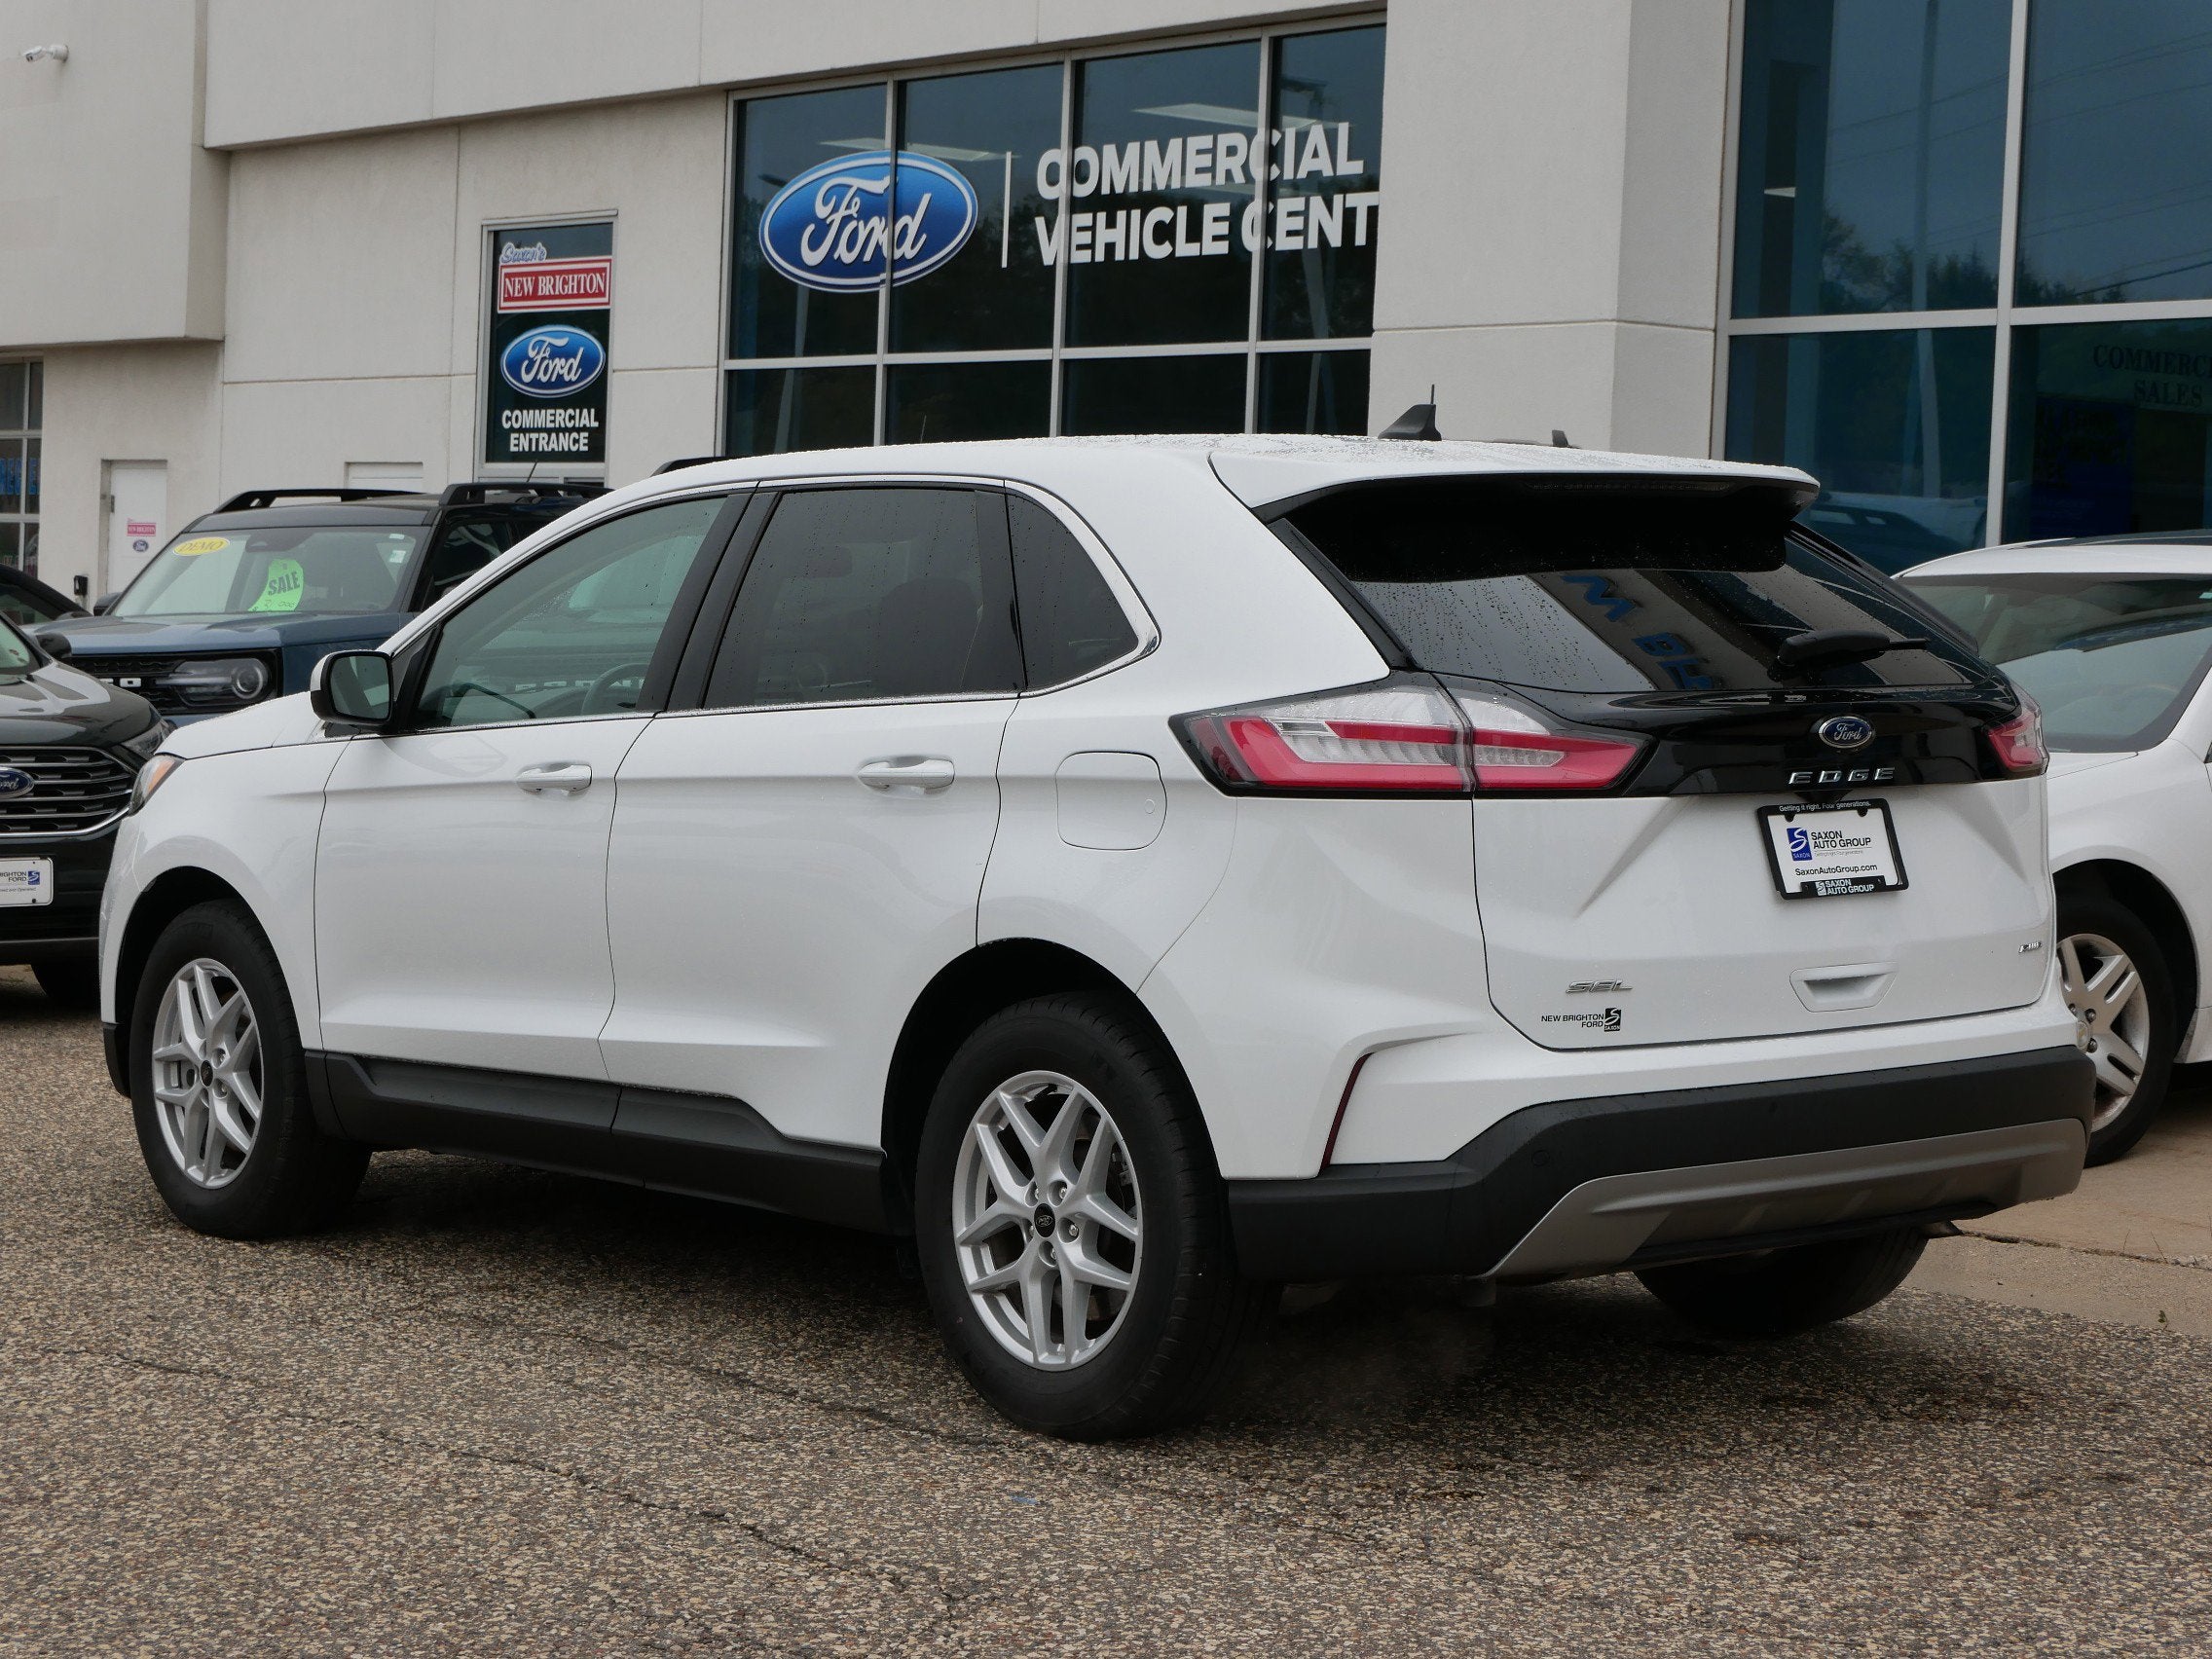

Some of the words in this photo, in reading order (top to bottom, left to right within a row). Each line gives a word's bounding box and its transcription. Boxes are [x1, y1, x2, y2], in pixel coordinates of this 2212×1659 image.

[1037, 122, 1364, 200] COMMERCIAL
[800, 175, 932, 267] Ford
[1034, 202, 1231, 267] VEHICLE
[1241, 191, 1380, 252] CENT
[504, 276, 535, 298] NEW
[537, 273, 606, 296] BRIGHTON
[520, 335, 584, 384] Ford
[2134, 380, 2203, 407] SALES
[501, 408, 599, 429] COMMERCIAL
[509, 432, 589, 453] ENTRANCE
[268, 571, 301, 595] SALE
[1788, 767, 1896, 784] EDGE
[1811, 830, 1843, 840] SAXON
[1813, 839, 1837, 849] AUTO
[1839, 837, 1871, 848] GROUP
[1794, 865, 1878, 876] SaxonAutoGroup.com
[1826, 886, 1848, 895] AUTO
[1848, 884, 1875, 894] GROUP
[1566, 979, 1633, 993] SEL
[1563, 1014, 1604, 1022] BRIGHTON
